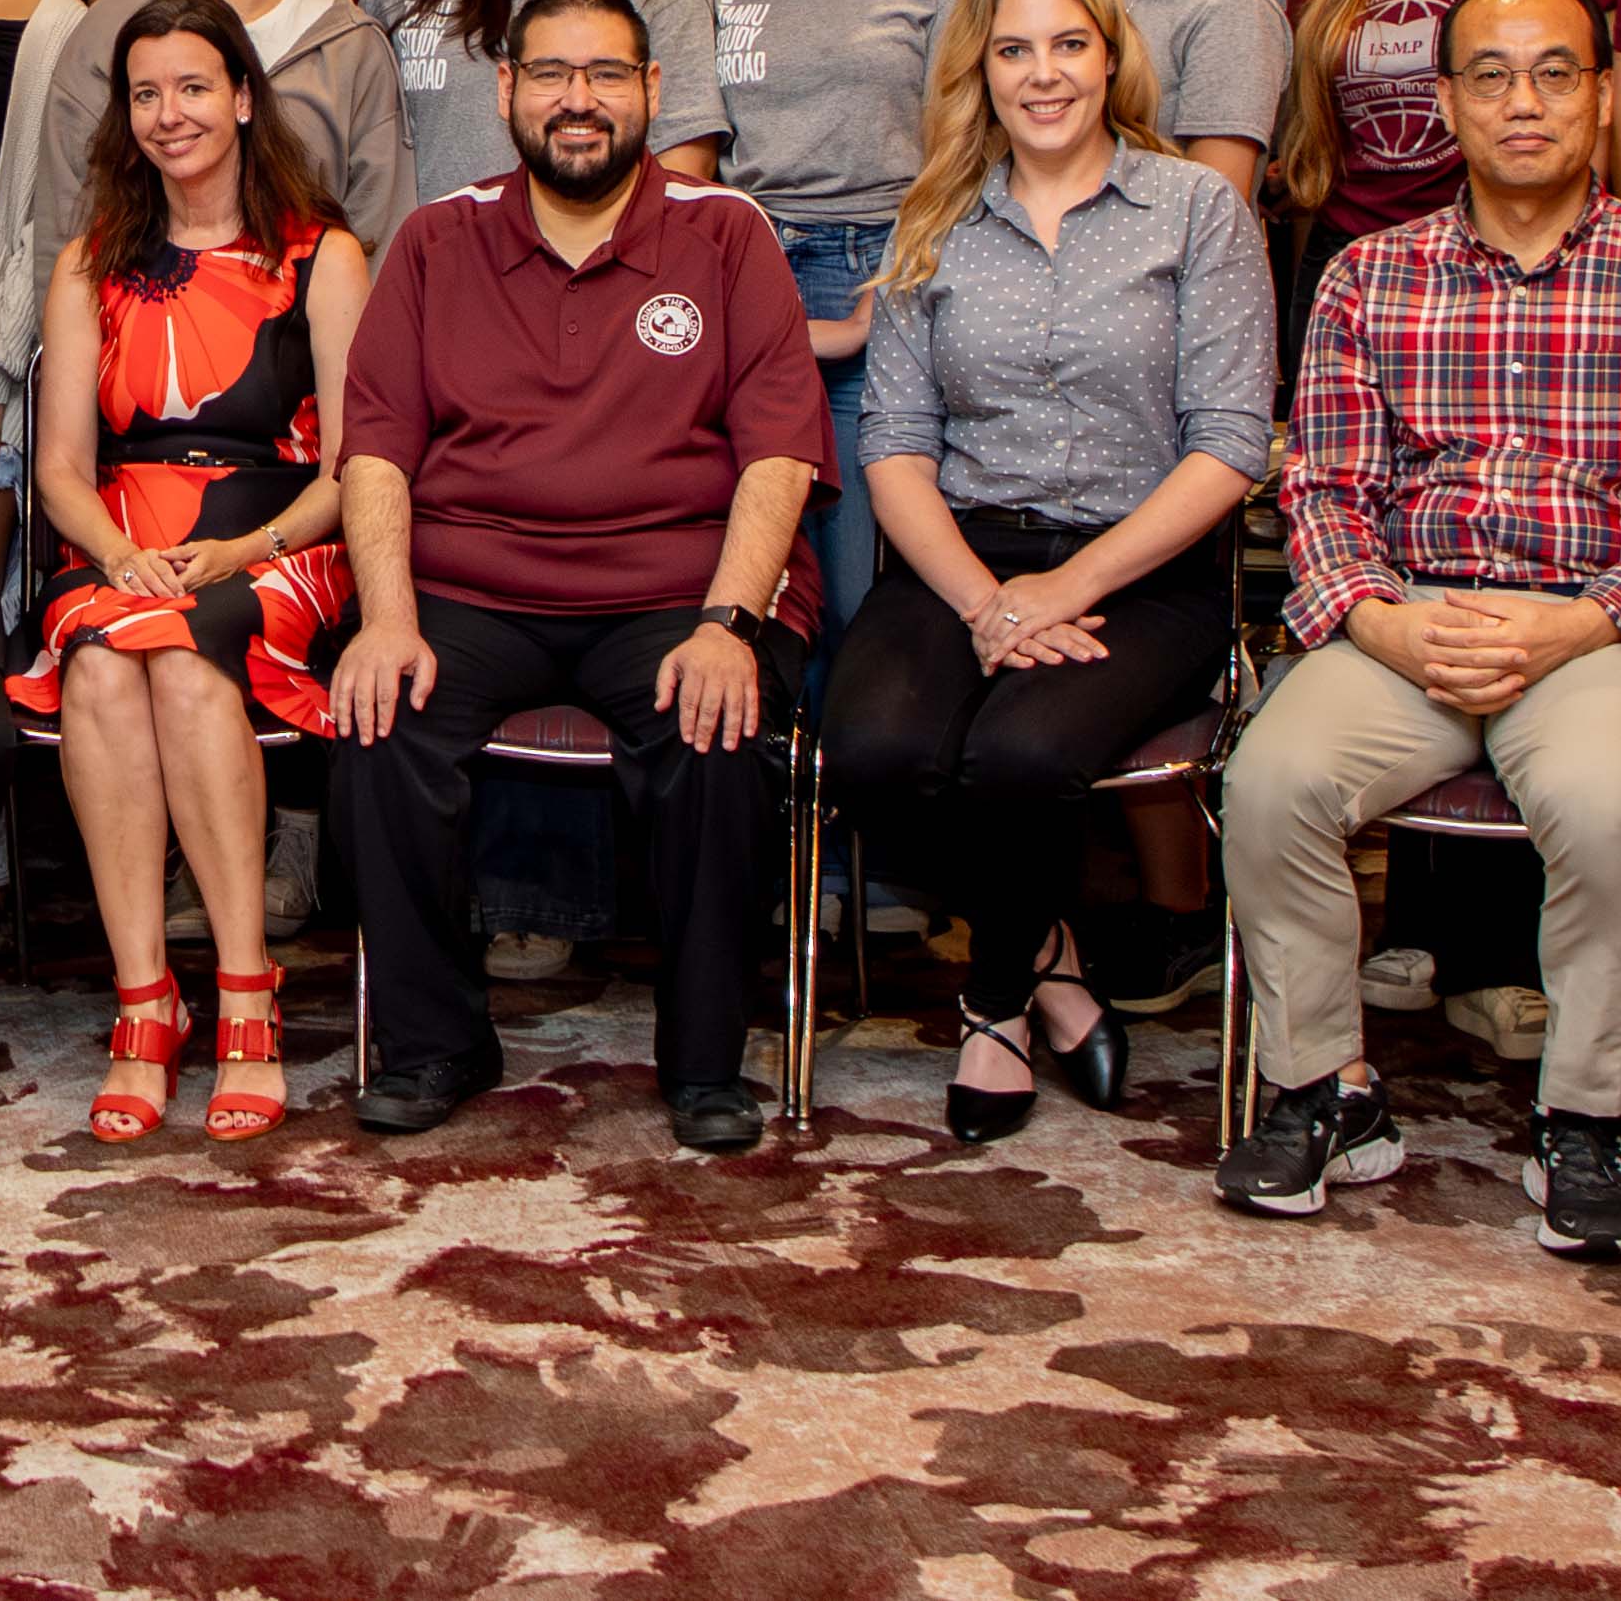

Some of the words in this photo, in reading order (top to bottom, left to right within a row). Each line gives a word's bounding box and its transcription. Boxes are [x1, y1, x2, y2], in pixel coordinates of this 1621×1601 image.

[718, 3, 771, 28] TAMIU
[398, 27, 445, 58] STUDY
[402, 58, 447, 91] BROAD
[715, 51, 766, 88] BROAD
[1396, 81, 1437, 96] PROGR
